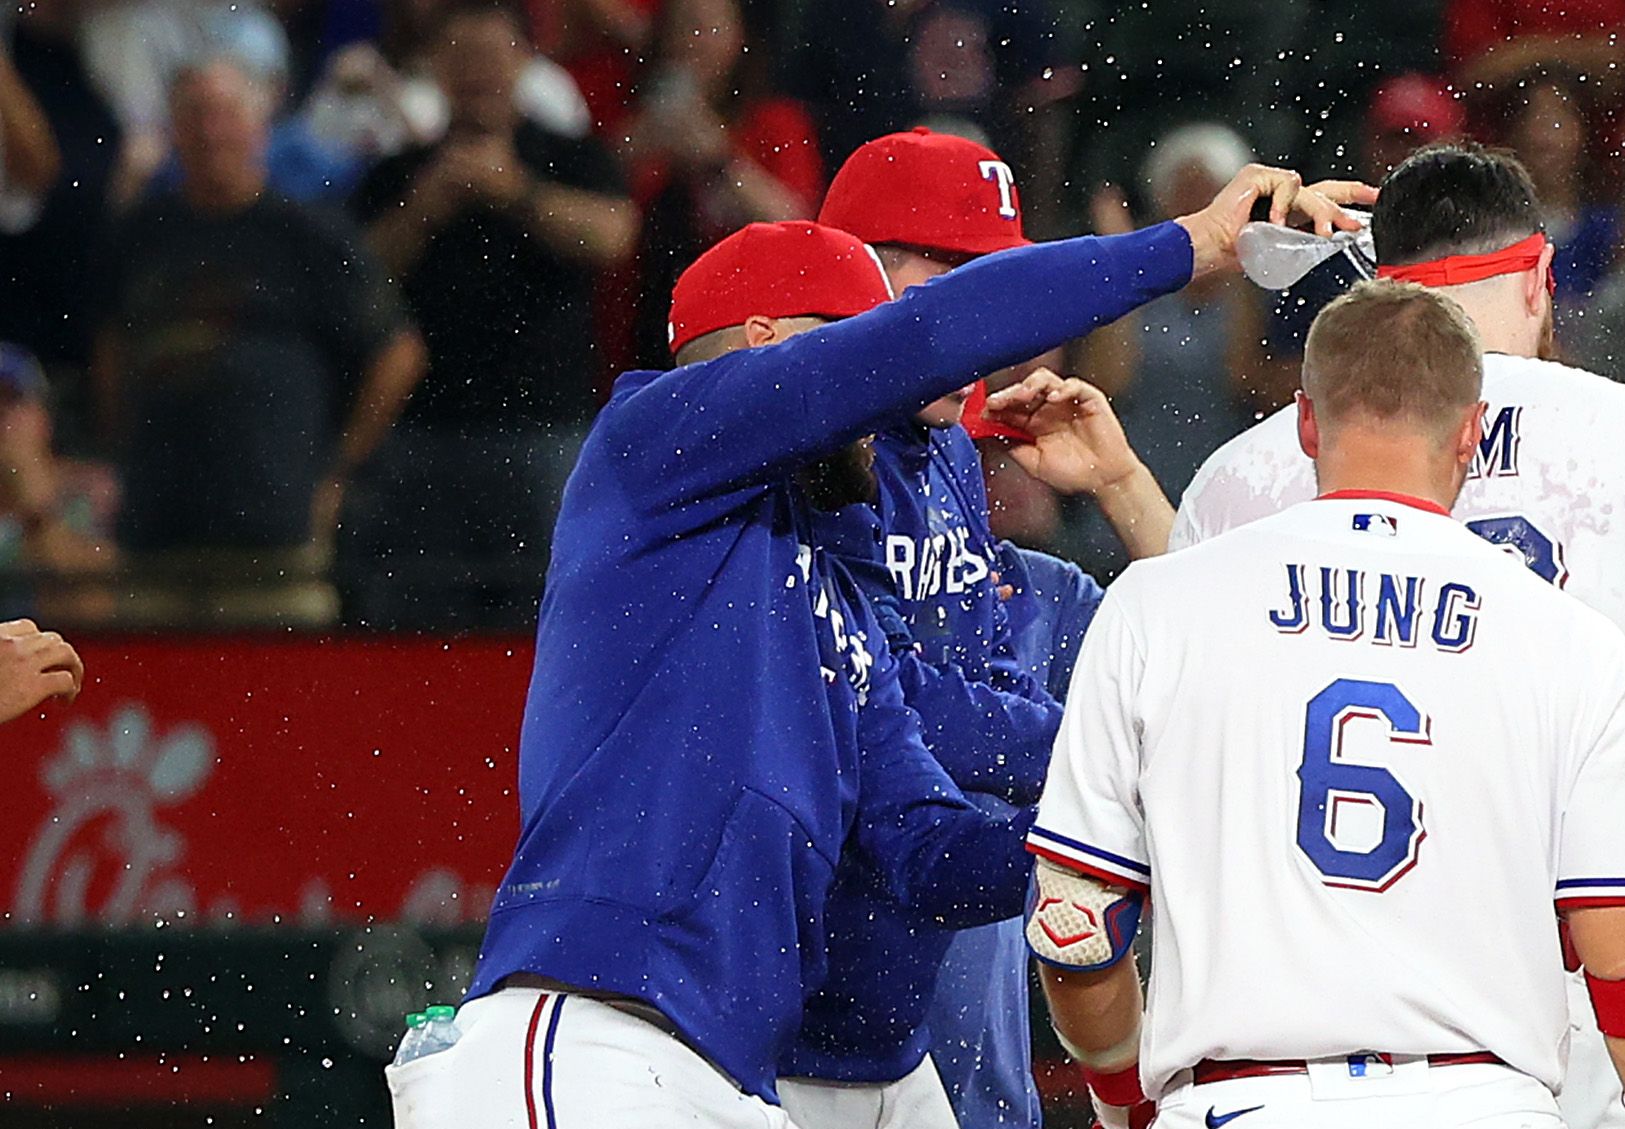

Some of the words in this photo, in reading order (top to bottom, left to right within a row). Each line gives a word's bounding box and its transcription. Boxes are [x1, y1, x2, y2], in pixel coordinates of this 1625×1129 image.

[978, 160, 1016, 220] T
[1268, 564, 1482, 653] JUNG
[1295, 677, 1432, 894] 6
